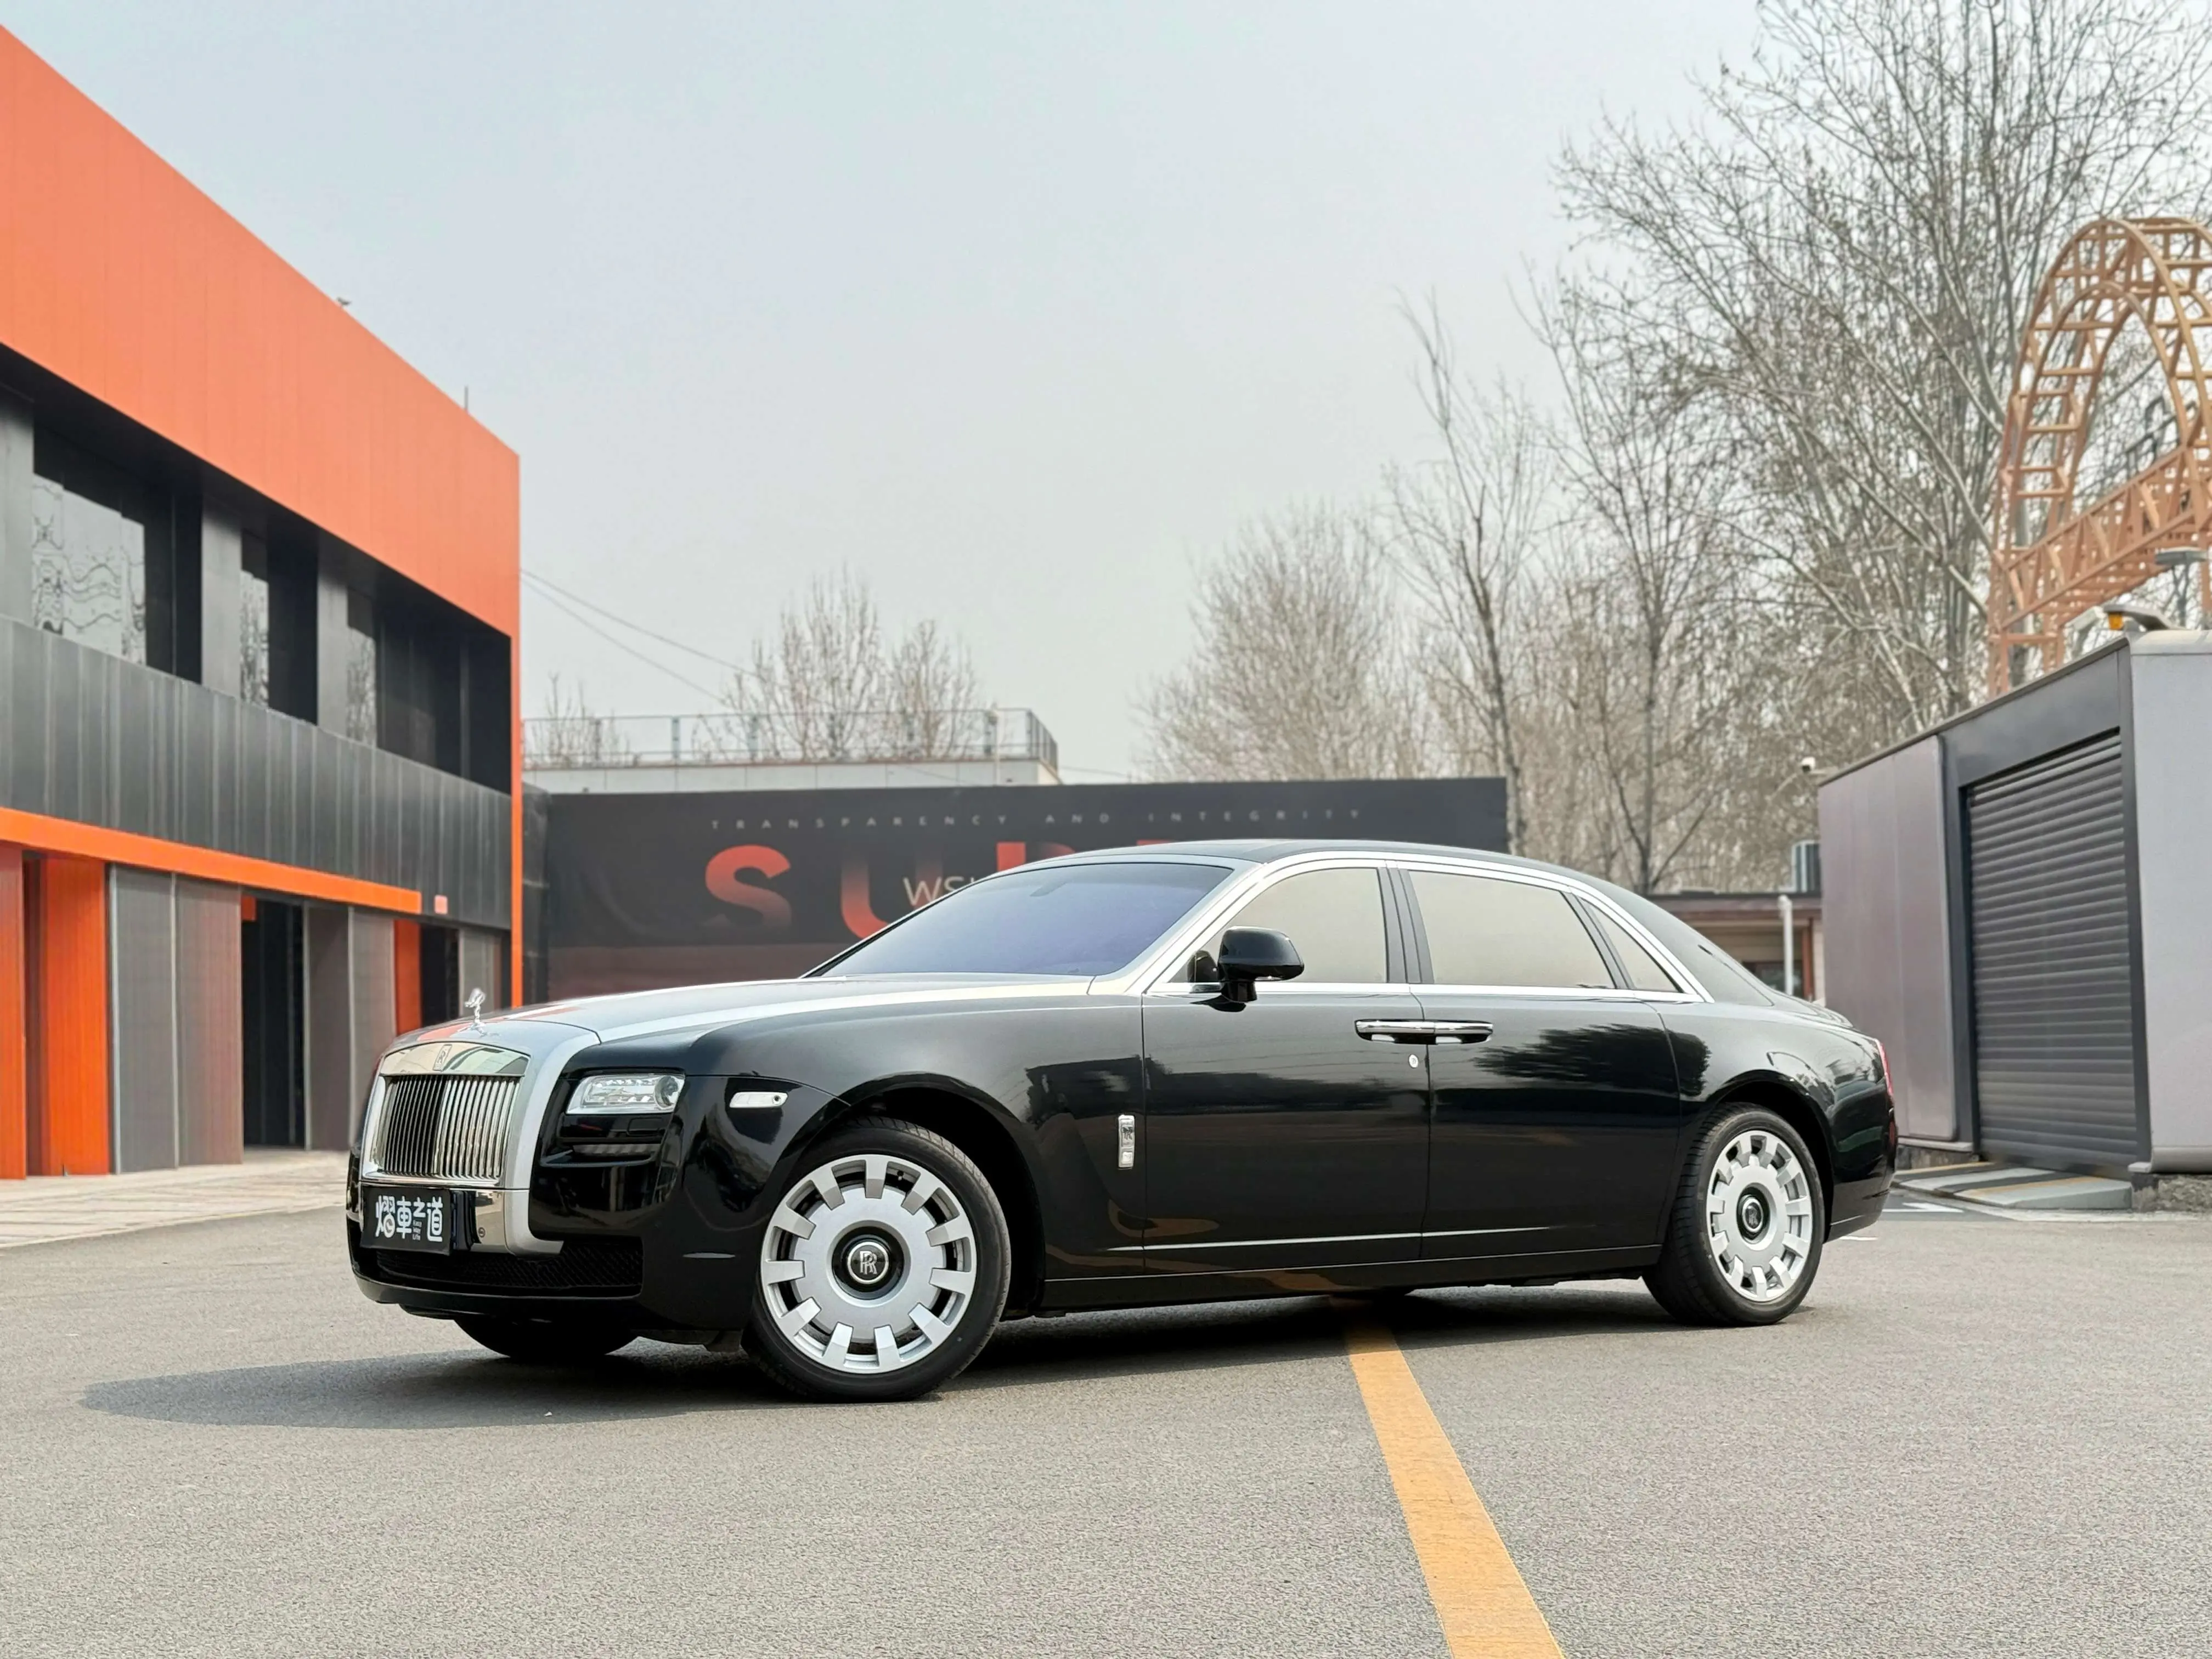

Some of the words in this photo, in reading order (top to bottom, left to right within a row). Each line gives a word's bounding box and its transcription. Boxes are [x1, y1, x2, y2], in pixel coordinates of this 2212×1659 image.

[712, 815, 1007, 829] TRANSPARENCY
[1045, 814, 1110, 823] AND
[1148, 810, 1359, 821] INTEGRITY
[859, 1250, 878, 1275] RR
